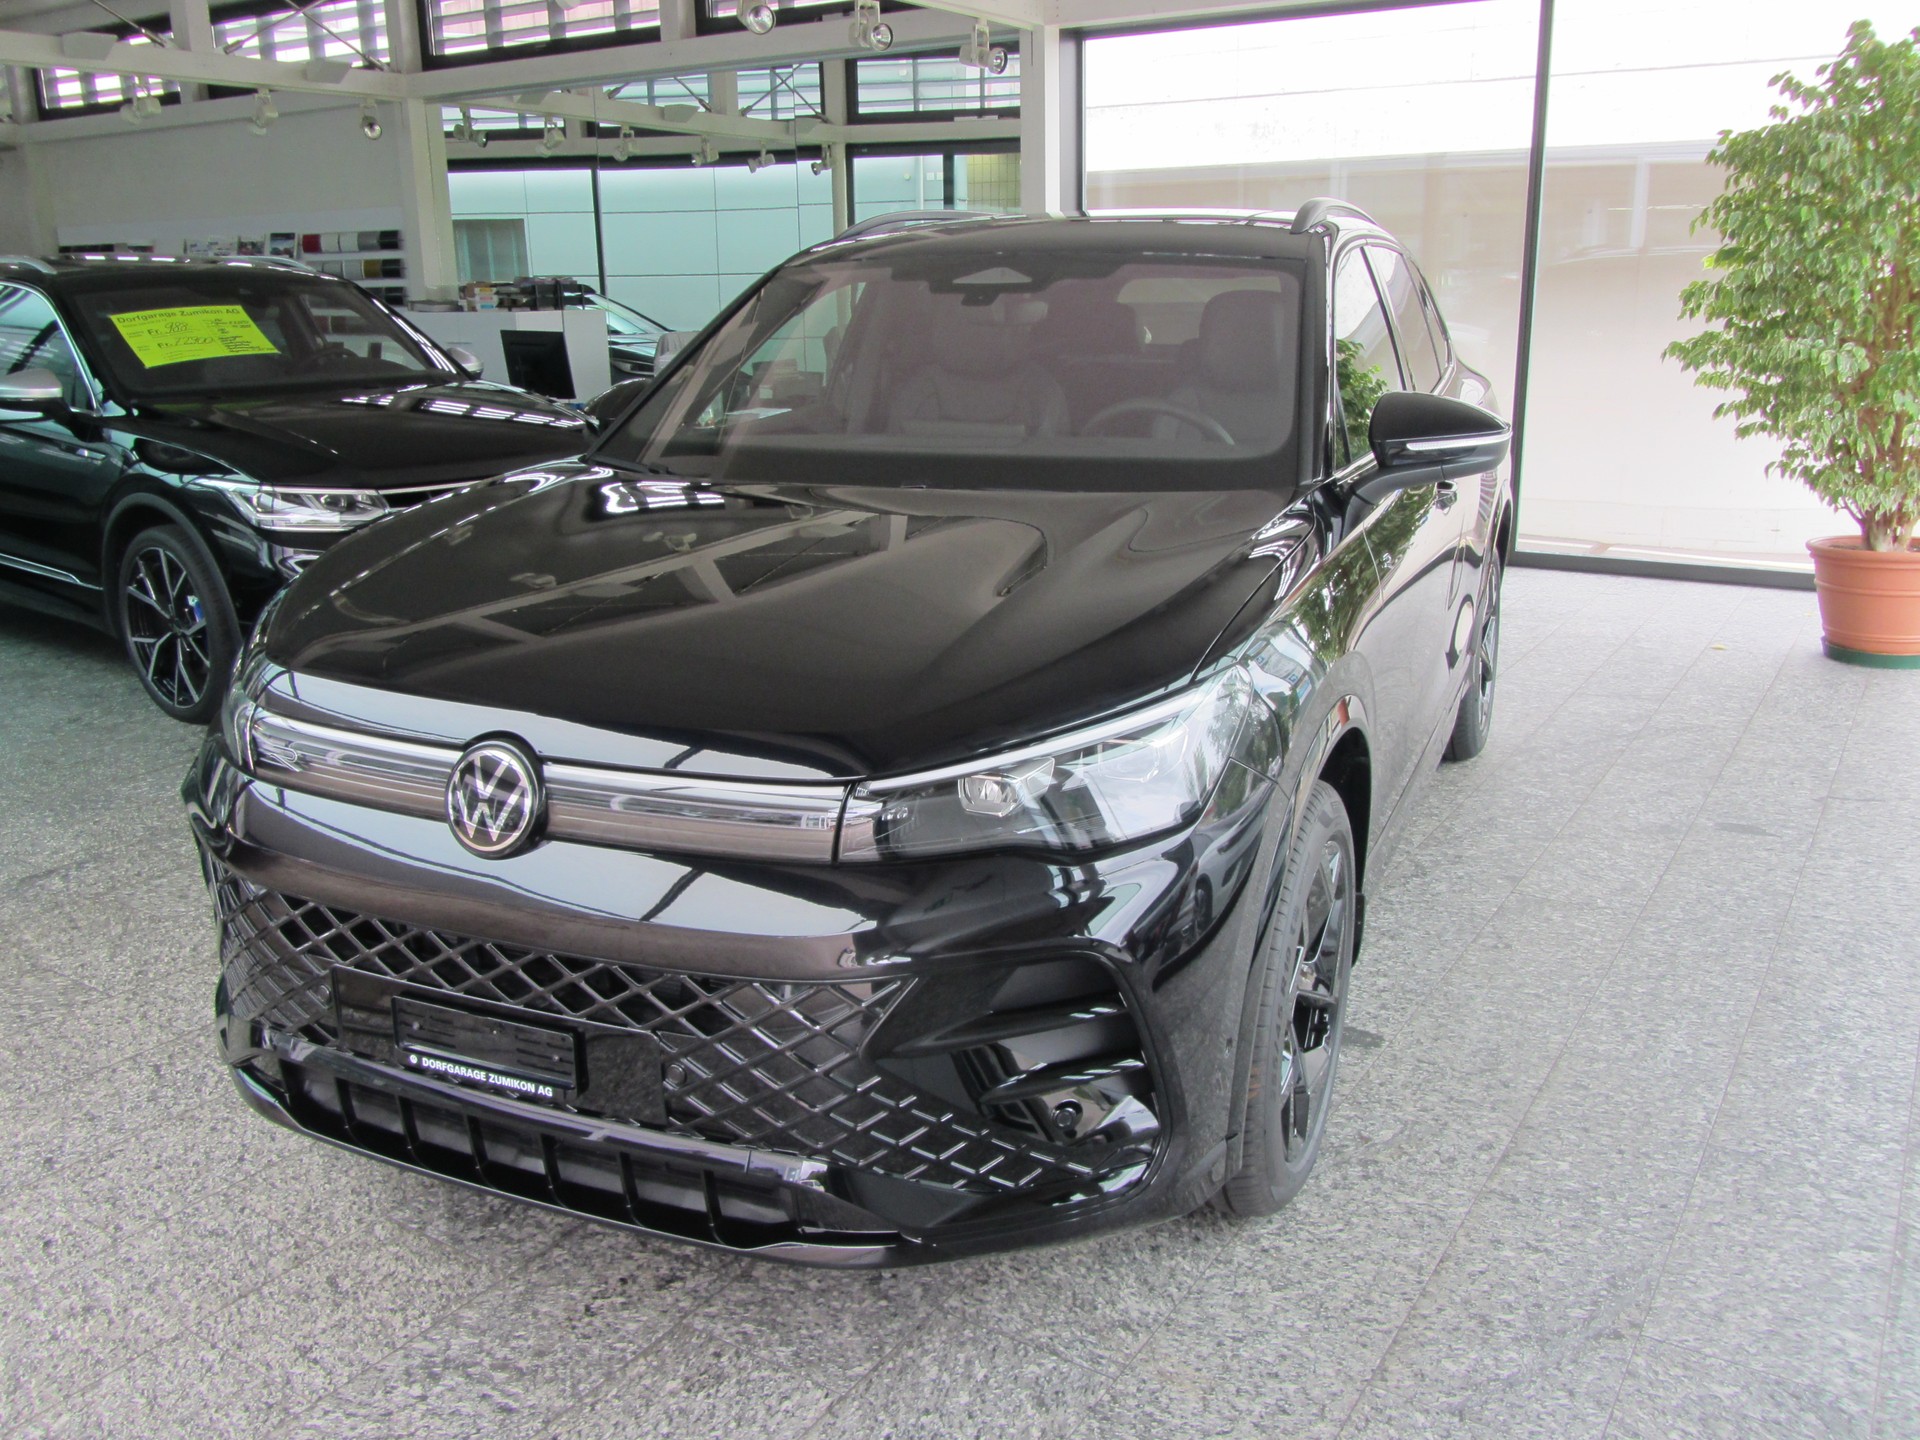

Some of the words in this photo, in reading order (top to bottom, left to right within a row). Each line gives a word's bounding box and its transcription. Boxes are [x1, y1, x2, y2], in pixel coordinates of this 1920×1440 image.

[117, 312, 177, 323] Dorfgarage
[179, 309, 223, 317] Zumikon
[421, 1056, 487, 1082] DORFGARAGE
[488, 1072, 536, 1094] ZUMIKON
[537, 1085, 554, 1098] AG
